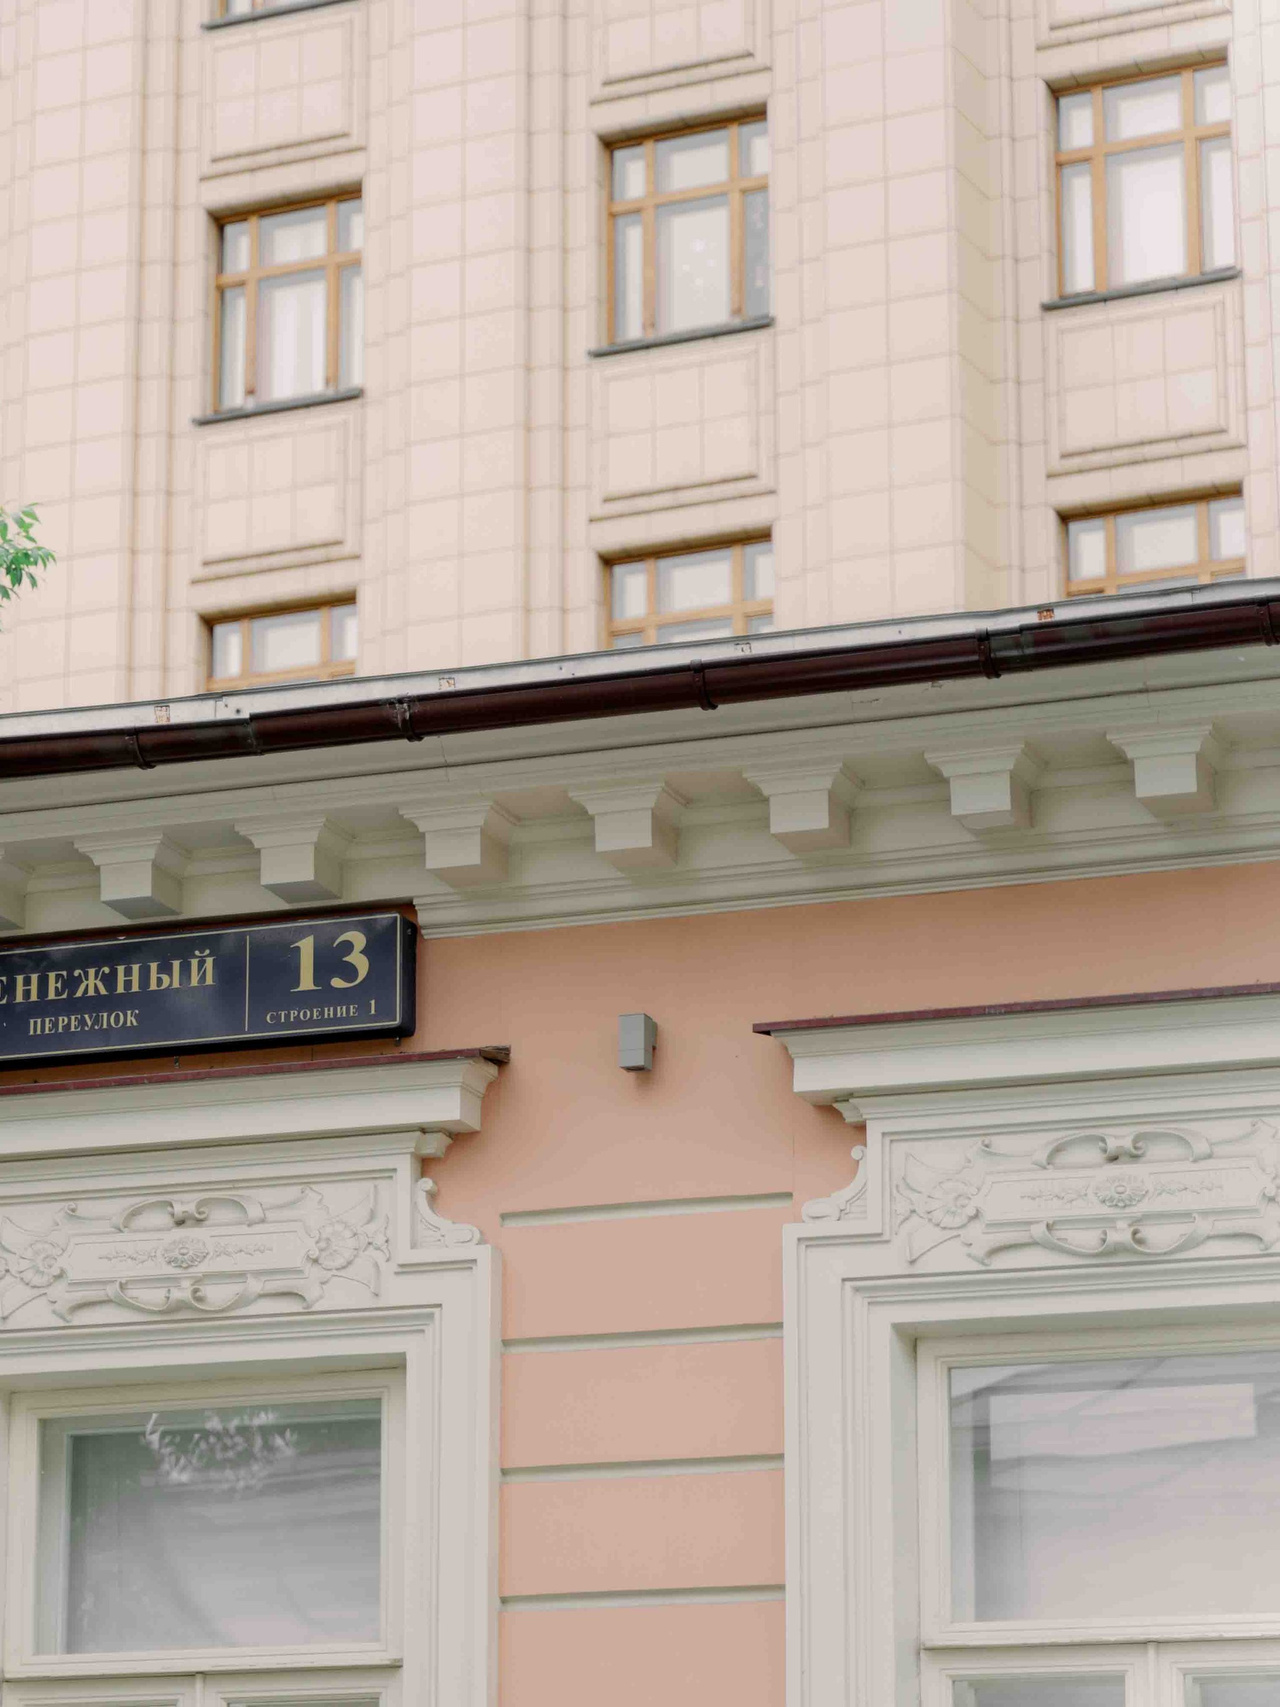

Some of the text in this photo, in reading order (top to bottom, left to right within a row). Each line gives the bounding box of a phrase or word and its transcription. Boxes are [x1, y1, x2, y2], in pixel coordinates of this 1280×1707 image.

[289, 930, 371, 992] 13
[28, 1009, 139, 1036] ПЕРЕУЛОК
[266, 999, 378, 1024] СТРОЕНИЕ 1
